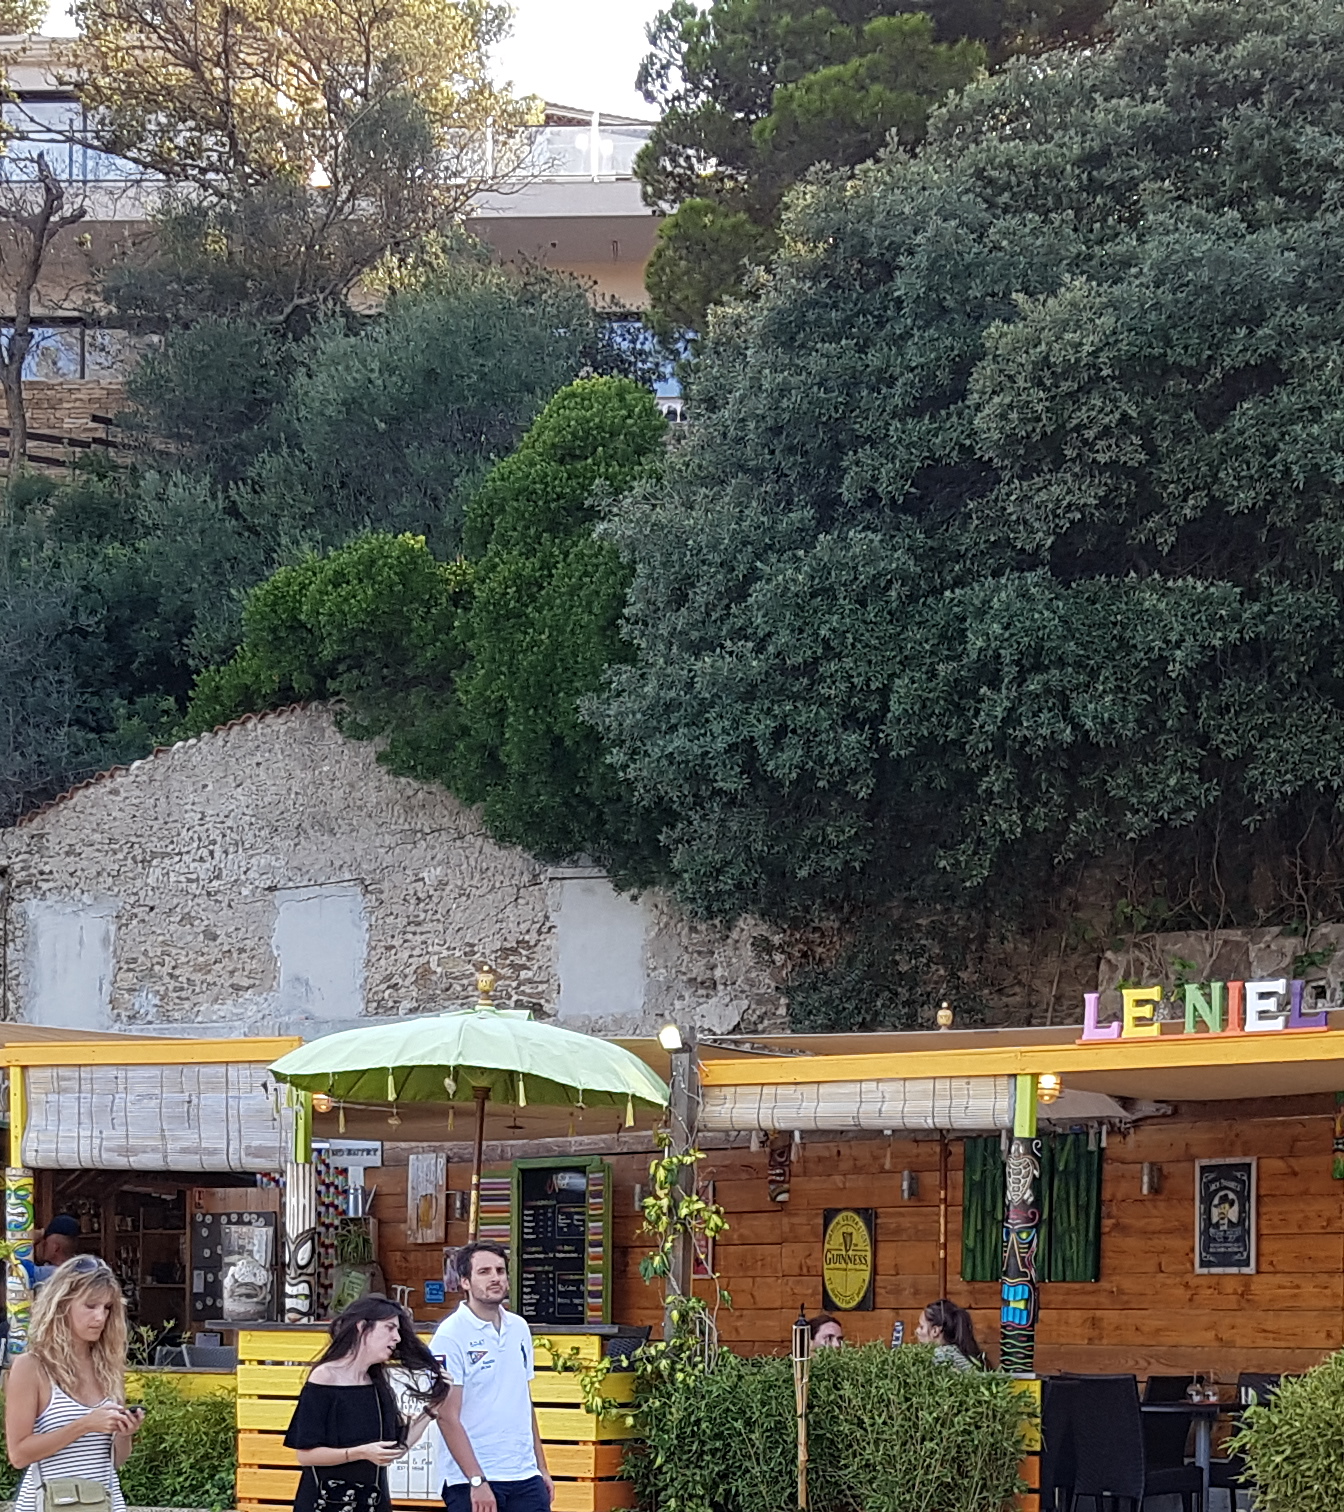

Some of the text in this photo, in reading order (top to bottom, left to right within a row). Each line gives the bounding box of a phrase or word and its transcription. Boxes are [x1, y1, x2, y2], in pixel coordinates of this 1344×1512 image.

[1081, 979, 1329, 1040] LE NIEL
[346, 1147, 379, 1157] ENTRY
